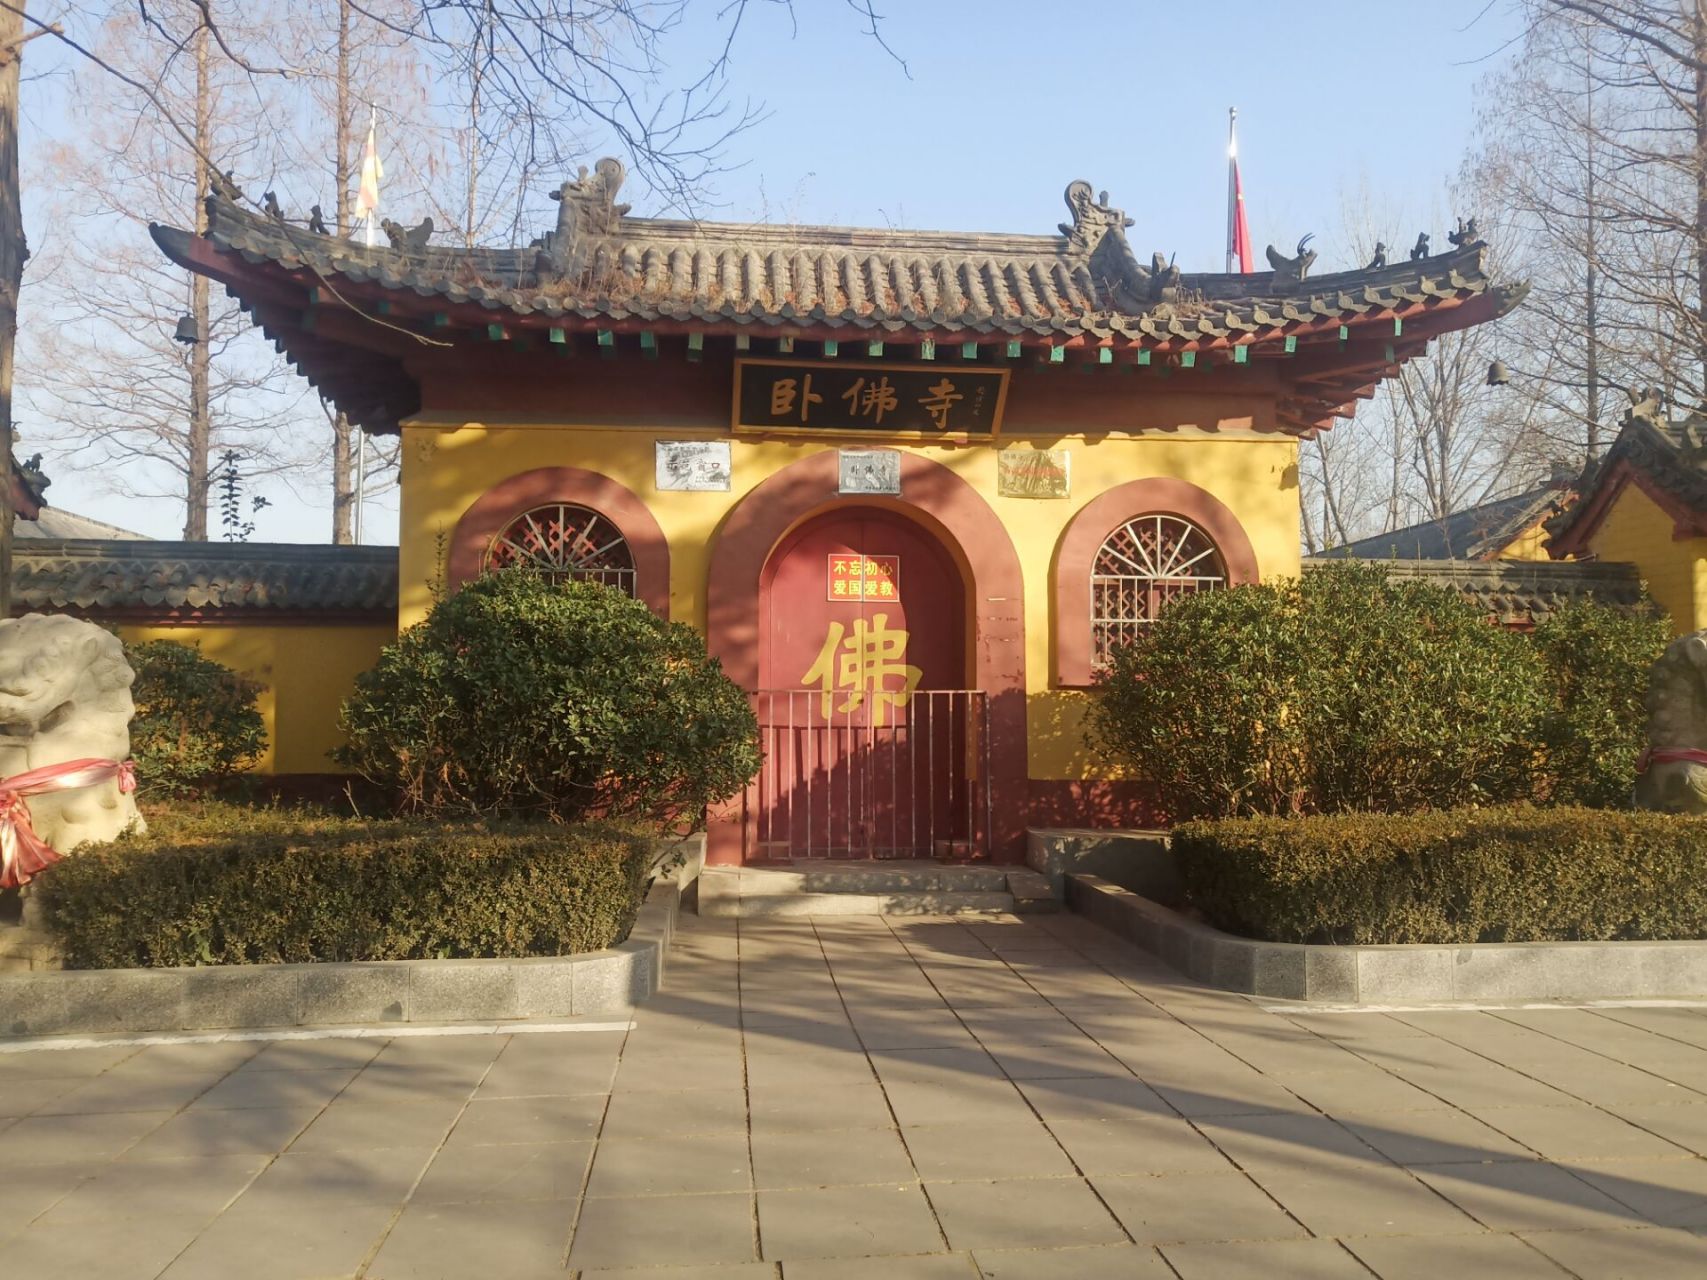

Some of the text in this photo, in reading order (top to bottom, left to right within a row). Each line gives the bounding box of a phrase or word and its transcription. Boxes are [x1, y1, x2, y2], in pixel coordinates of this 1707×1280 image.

[770, 373, 964, 430] 卧佛寺
[833, 560, 893, 577] 不忘初心
[833, 579, 894, 597] 爱国爱教
[801, 612, 924, 728] 佛
